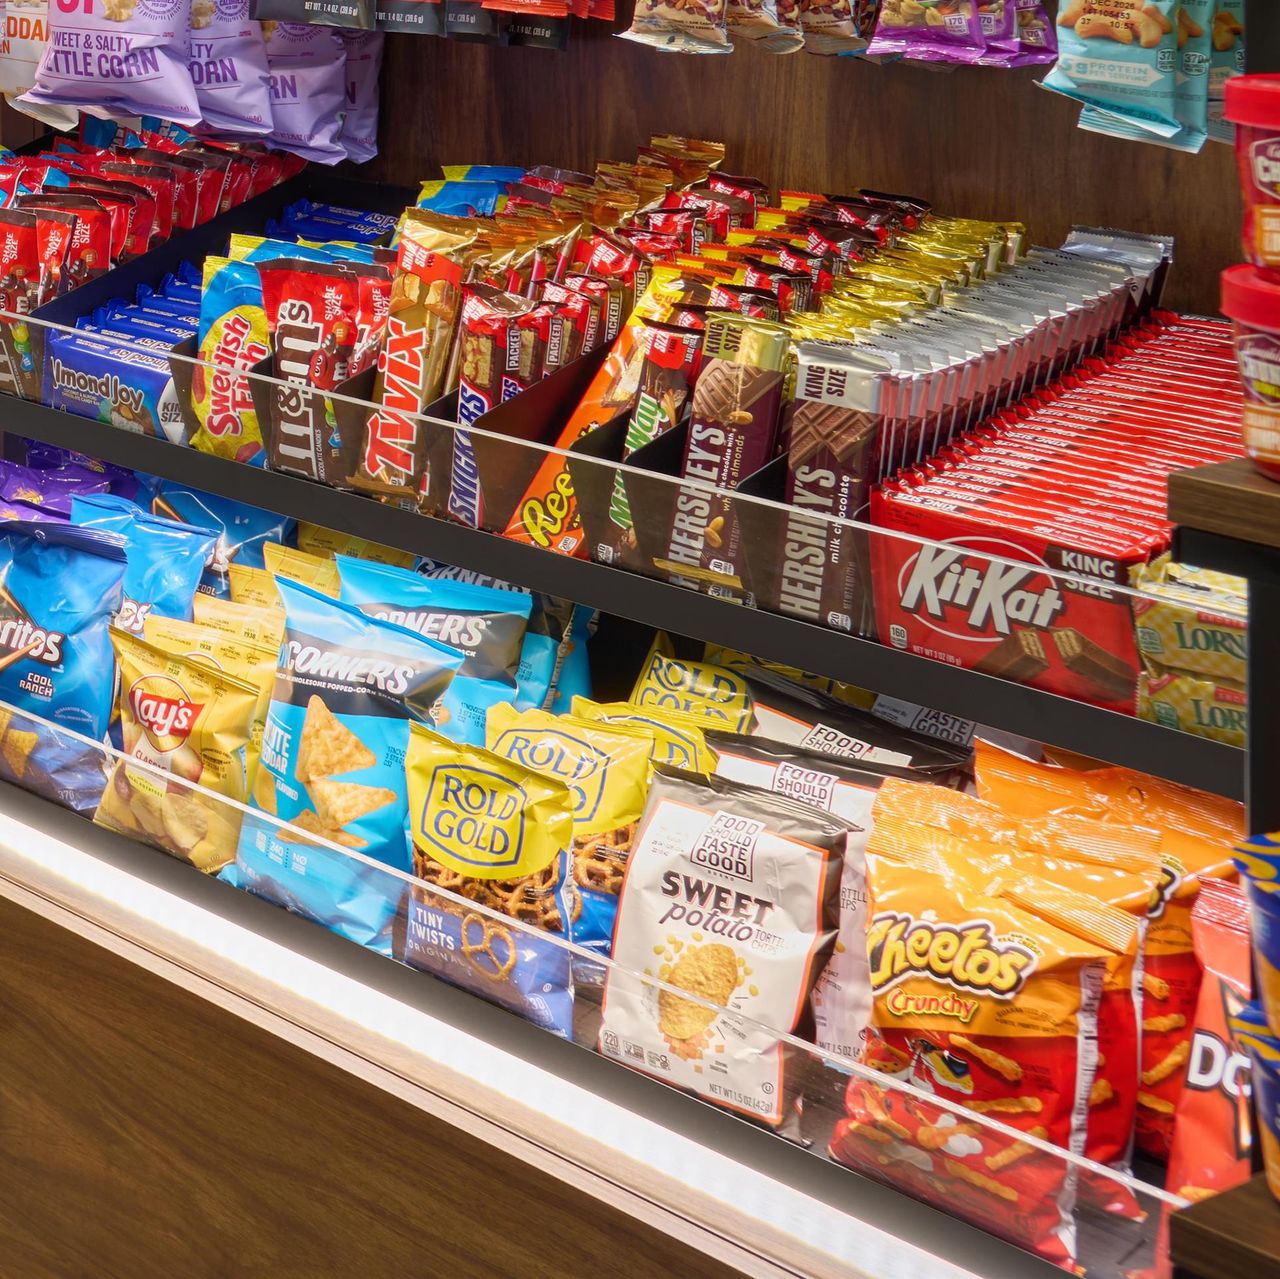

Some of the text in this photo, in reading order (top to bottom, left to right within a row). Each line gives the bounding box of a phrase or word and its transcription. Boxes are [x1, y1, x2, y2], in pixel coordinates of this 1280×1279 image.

[98, 49, 159, 79] CORN
[206, 314, 250, 437] Swedish
[827, 365, 847, 397] SIZE
[1061, 550, 1116, 578] KING
[19, 680, 53, 698] RANCH
[27, 672, 53, 686] COOL
[133, 687, 193, 737] Lay's
[442, 773, 516, 822] ROLD
[434, 811, 512, 856] GOLD
[707, 823, 759, 848] SHOULD
[712, 813, 765, 835] FOOD
[701, 836, 754, 865] TASTE
[660, 870, 775, 927] SWEET
[415, 907, 444, 932] TINY
[659, 899, 754, 942] potato
[411, 920, 456, 951] TWISTS
[886, 987, 978, 1022] Crunchy
